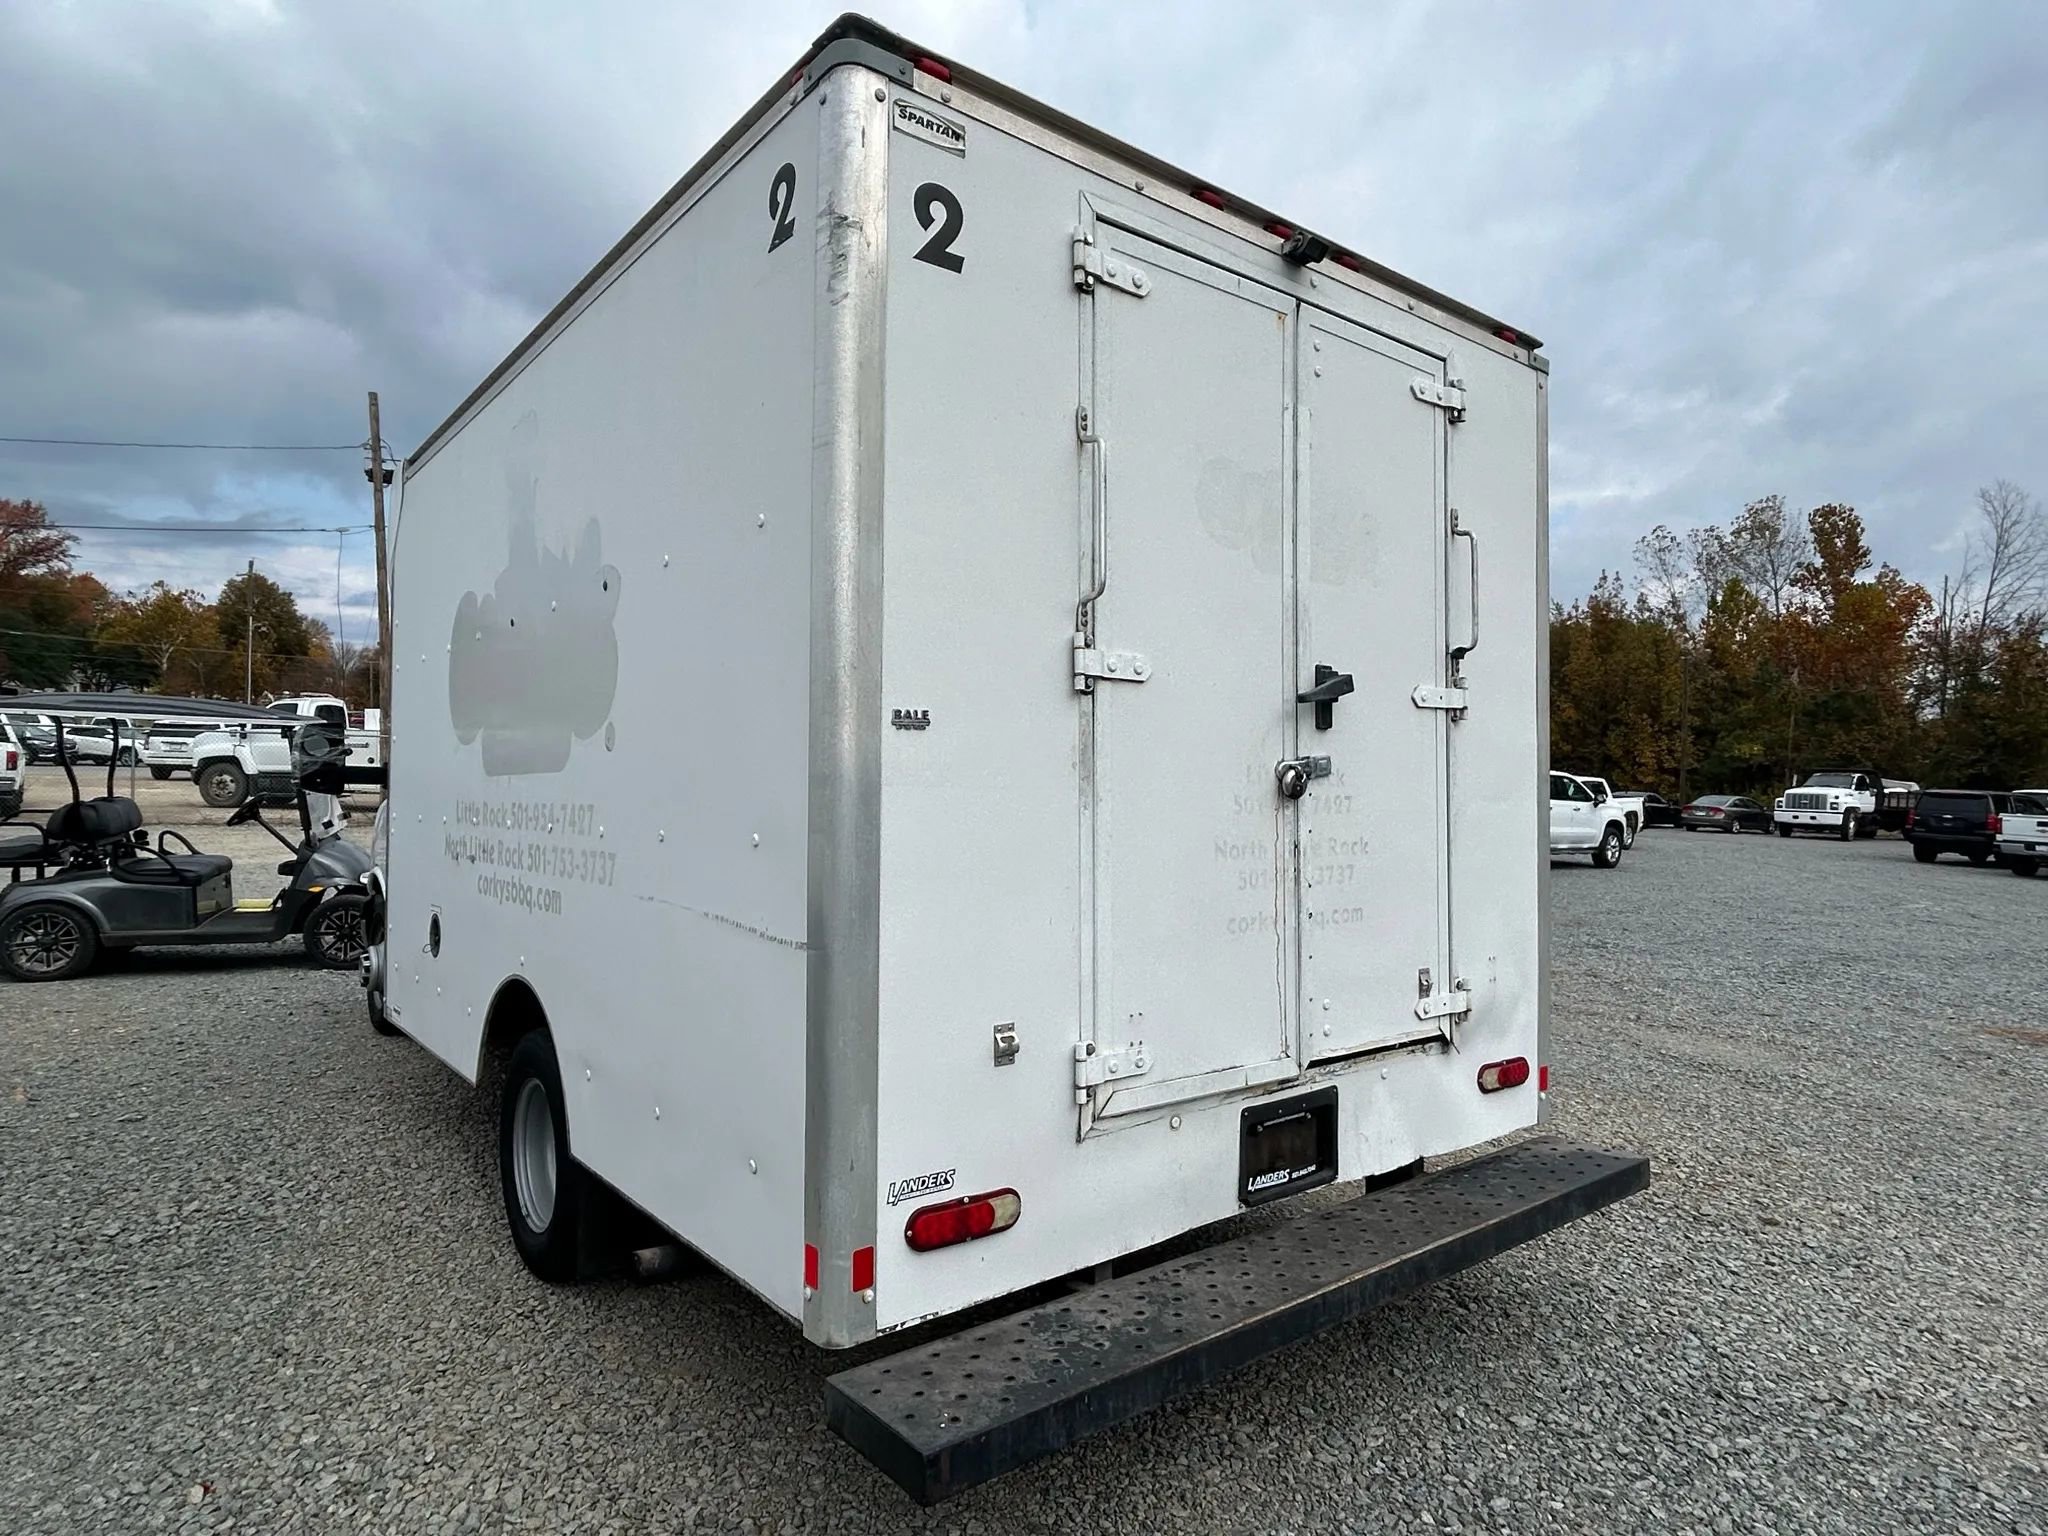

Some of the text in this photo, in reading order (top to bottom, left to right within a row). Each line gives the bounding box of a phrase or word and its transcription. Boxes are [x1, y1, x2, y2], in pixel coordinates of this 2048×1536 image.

[897, 107, 961, 142] SPARTAN
[768, 162, 797, 254] 2
[912, 182, 965, 274] 2
[892, 708, 930, 721] BALE
[456, 800, 481, 826] Little
[482, 800, 507, 827] Rock
[497, 839, 524, 871] Rock
[527, 843, 617, 887] 501-753-3737
[1328, 836, 1370, 856] Rock
[477, 872, 562, 915] corkysbbq.com
[887, 1168, 956, 1206] LANDERS
[1247, 1168, 1290, 1192] LANDERS
